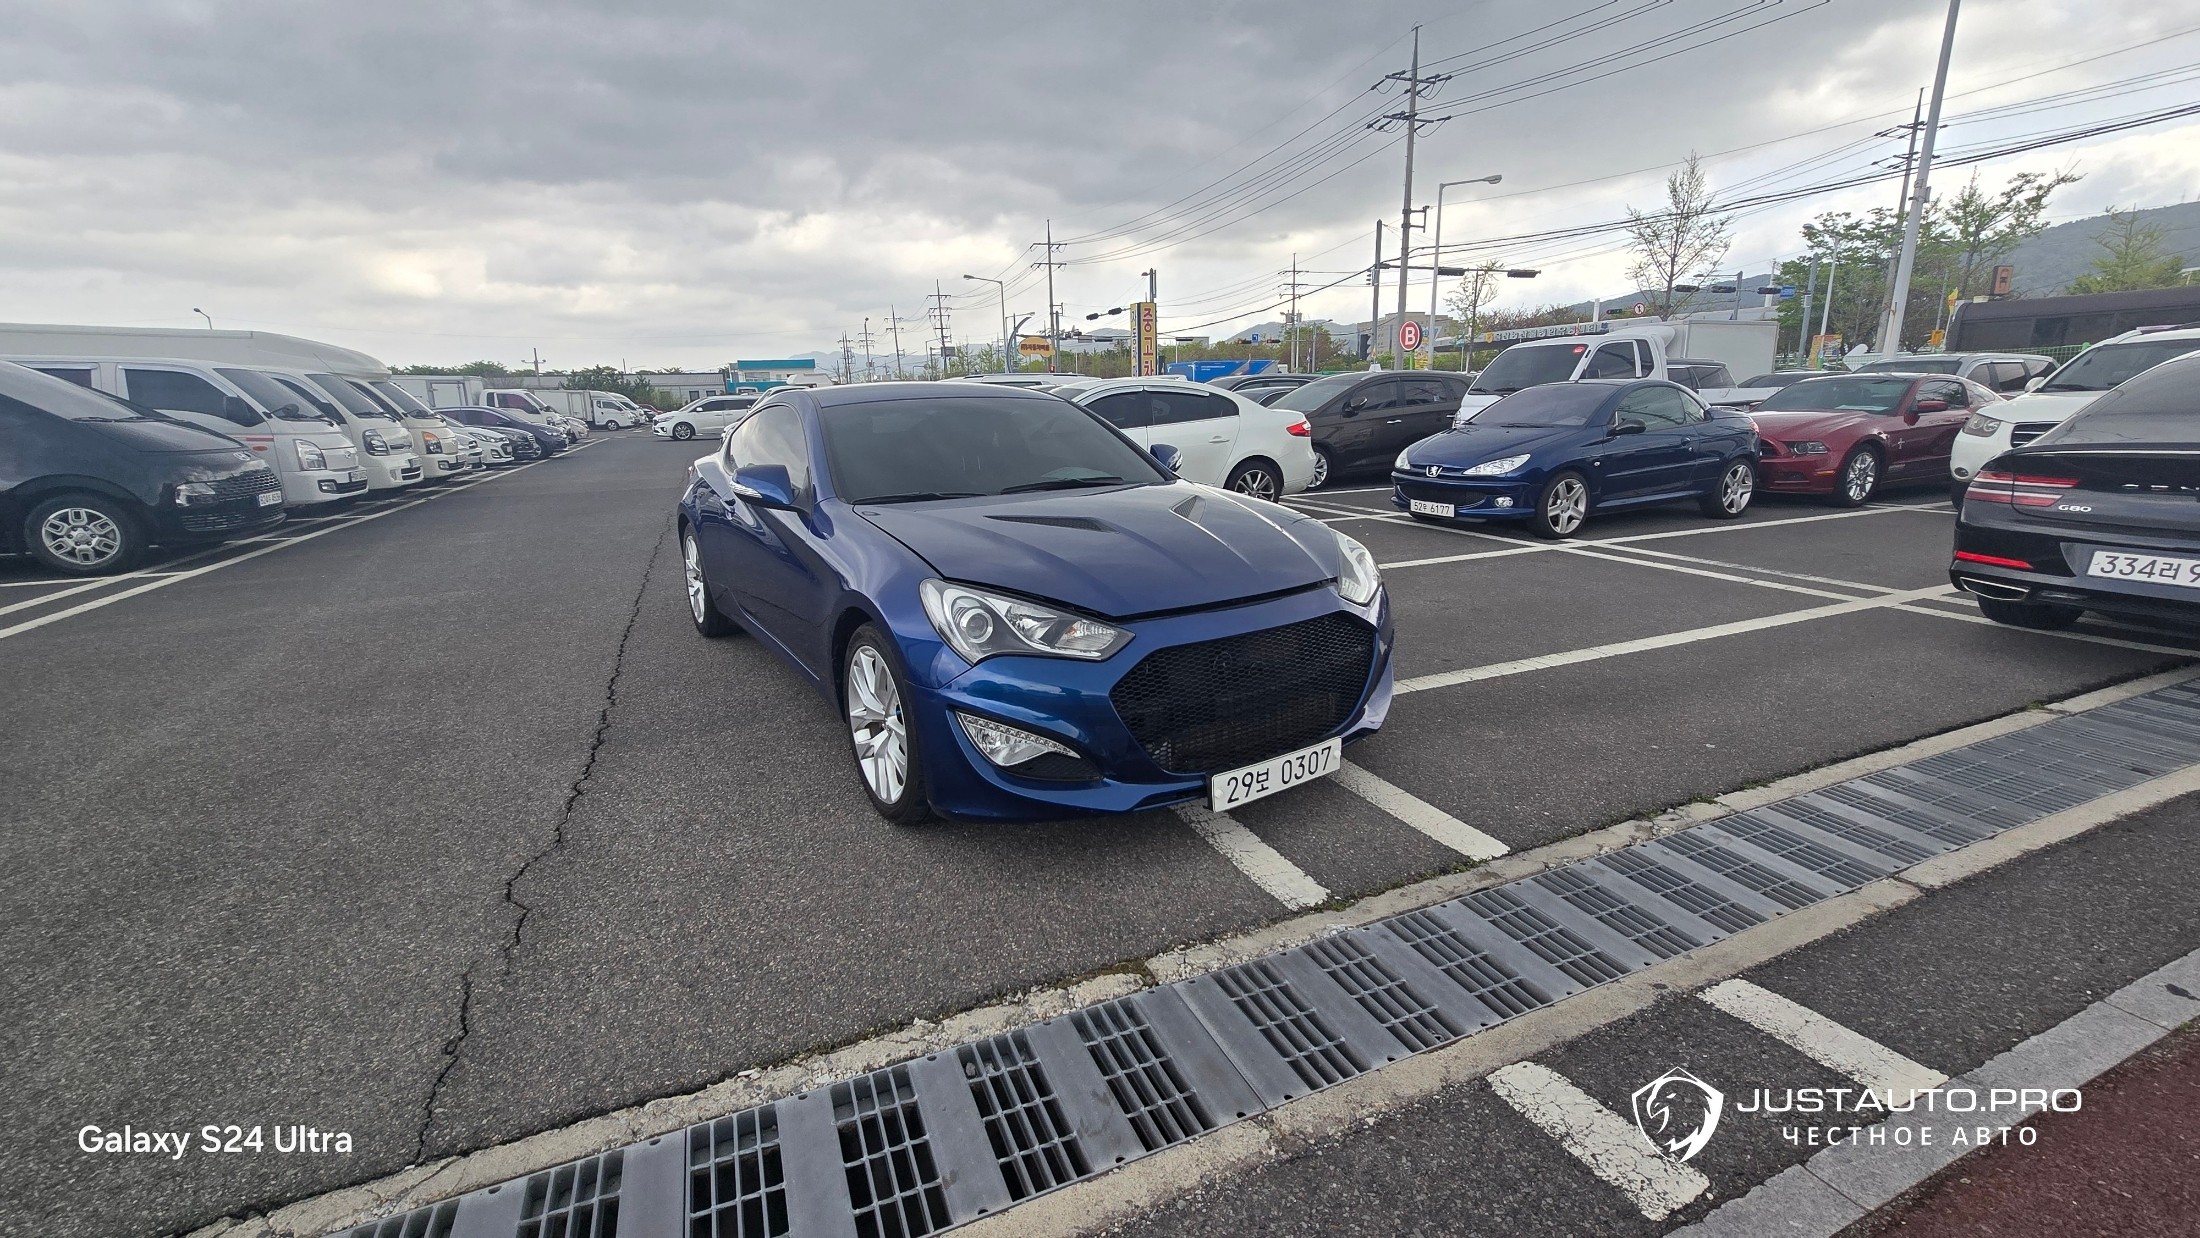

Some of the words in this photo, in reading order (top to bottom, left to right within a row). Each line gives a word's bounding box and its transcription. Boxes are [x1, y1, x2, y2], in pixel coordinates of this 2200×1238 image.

[1405, 326, 1416, 346] B
[1430, 503, 1450, 515] 6177
[2058, 504, 2092, 512] G80
[2100, 555, 2182, 580] 334러
[1226, 767, 1270, 804] 29보
[1281, 745, 1332, 785] 0307
